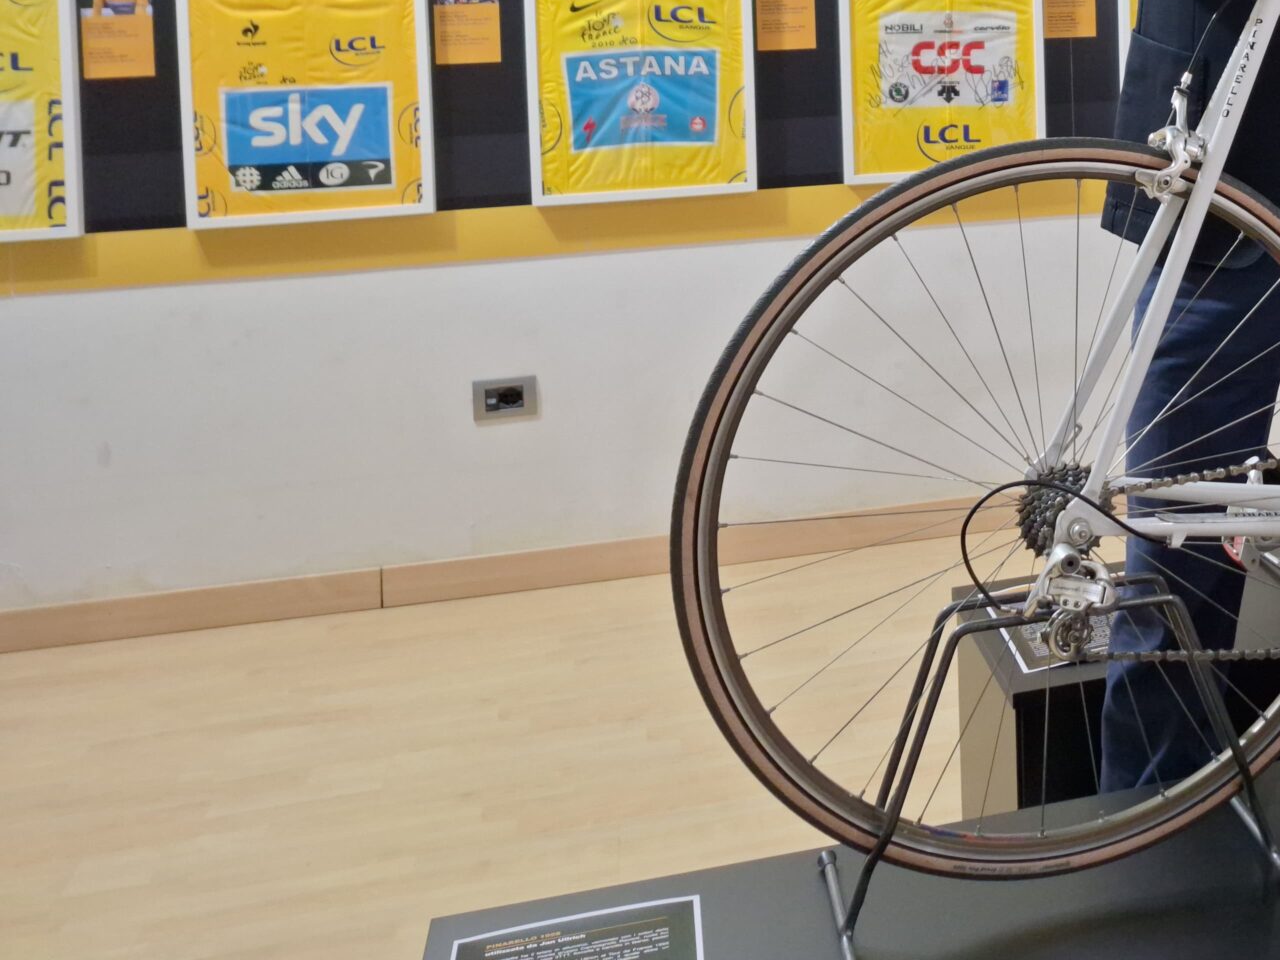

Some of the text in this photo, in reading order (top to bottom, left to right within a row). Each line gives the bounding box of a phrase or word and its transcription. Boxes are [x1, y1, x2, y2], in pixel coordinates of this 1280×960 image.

[654, 4, 717, 24] LCL
[884, 23, 923, 33] NOBILI
[333, 35, 385, 52] LCL
[911, 40, 986, 75] CSC
[575, 54, 710, 82] ASTANA
[1220, 17, 1264, 119] PINARELLO
[249, 92, 366, 157] sky
[923, 123, 981, 144] LCL
[272, 175, 309, 189] adidas
[325, 166, 344, 180] IG
